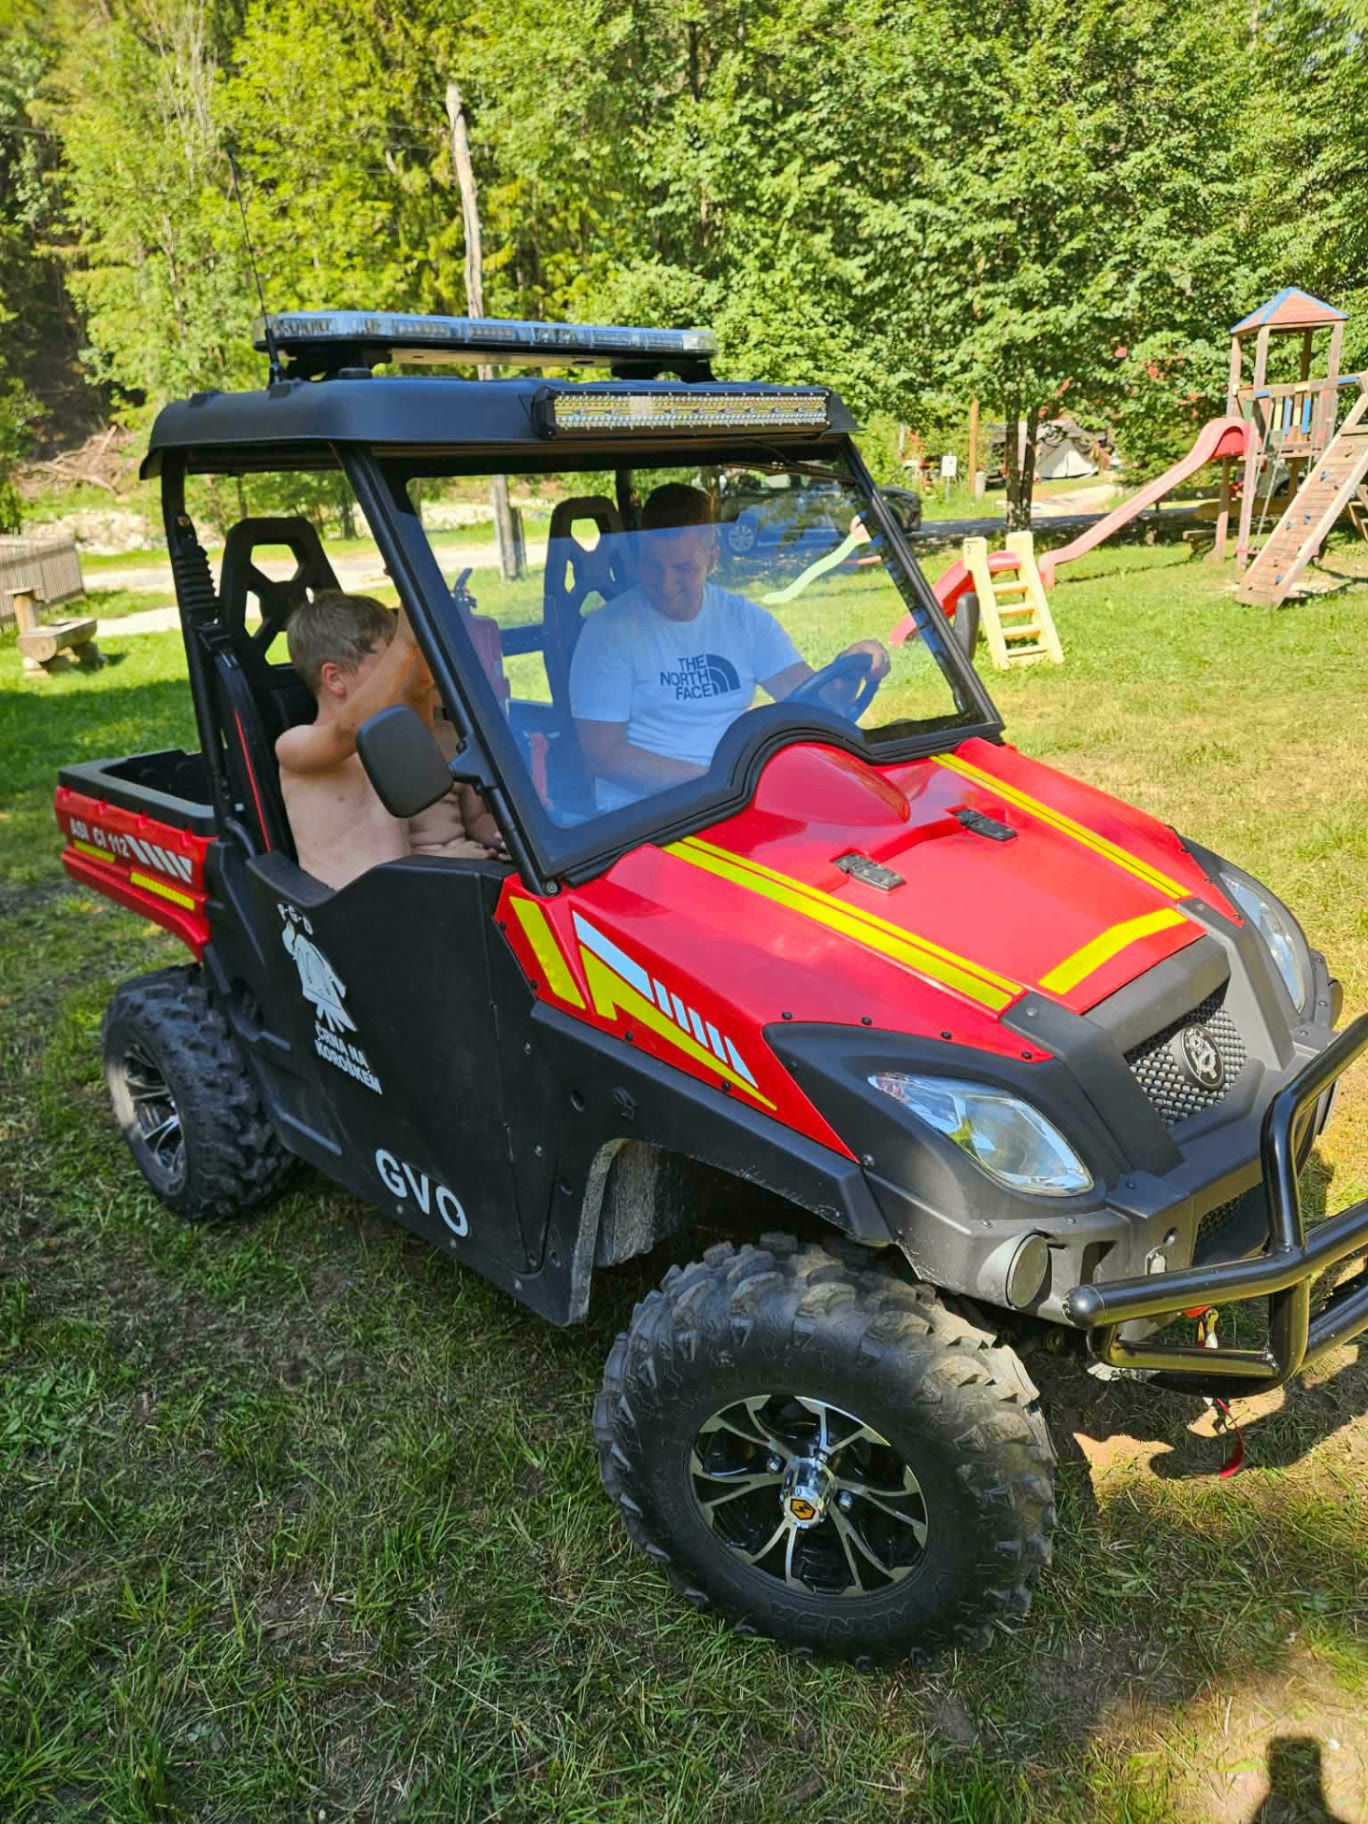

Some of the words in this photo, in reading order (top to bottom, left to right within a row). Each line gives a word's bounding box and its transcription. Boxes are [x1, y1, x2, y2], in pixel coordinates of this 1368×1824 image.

[677, 654, 707, 671] THE
[660, 669, 710, 686] NORTH
[676, 683, 712, 700] FACE
[108, 832, 131, 858] 112
[347, 1043, 370, 1070] NA
[375, 1148, 469, 1238] GVO
